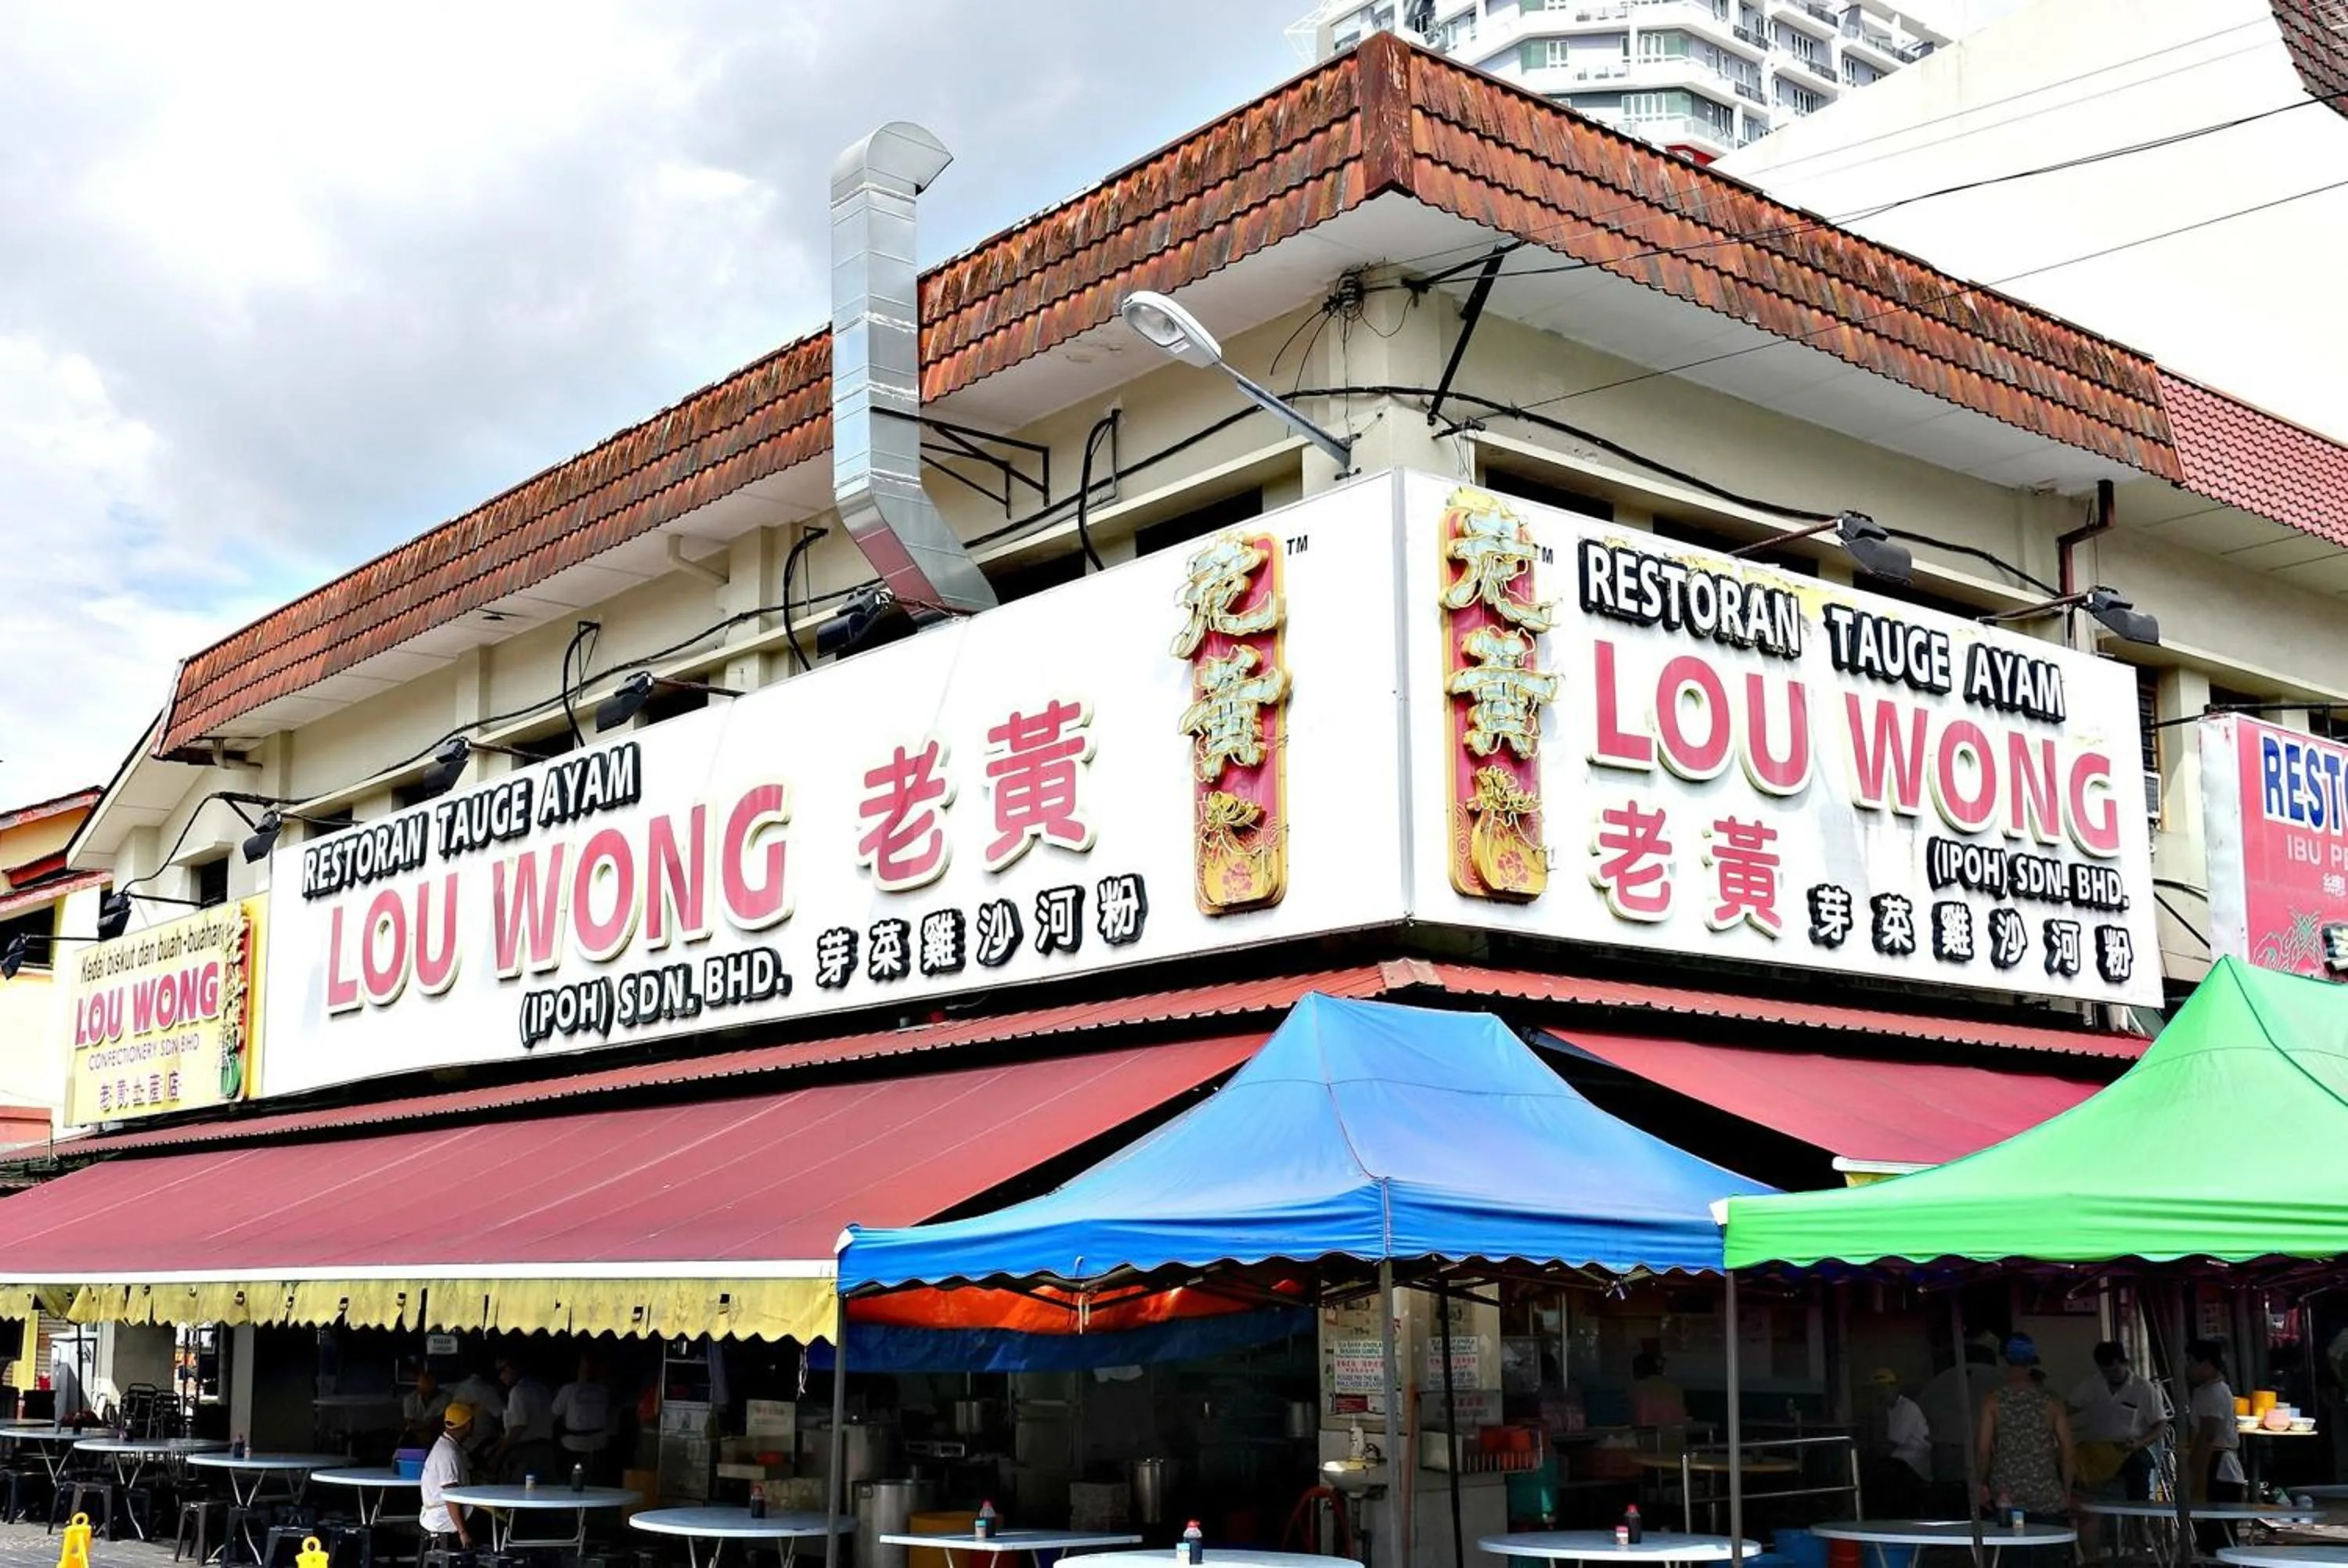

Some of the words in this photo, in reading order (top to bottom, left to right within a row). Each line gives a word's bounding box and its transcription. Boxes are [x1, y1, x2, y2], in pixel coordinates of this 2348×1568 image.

[1286, 534, 1308, 556] TM
[1579, 538, 1802, 660] RESTORAN
[1824, 603, 1950, 694] TAUGE
[1964, 643, 2066, 723] AYAM
[1590, 638, 1813, 795] LOU
[1845, 691, 2122, 858] WONG
[2263, 735, 2348, 832] REST
[303, 811, 428, 897] RESTORAN
[438, 777, 534, 856] TAUGE
[538, 742, 640, 826] AYAM
[2287, 834, 2322, 865] IBU
[327, 871, 460, 1012] LOU
[492, 783, 793, 978] WONG
[1928, 836, 2008, 899] (IPOH)
[2009, 853, 2070, 903] SDN.
[2070, 864, 2130, 912] BHD.
[75, 987, 124, 1046] LOU
[132, 961, 219, 1036] WONG
[81, 951, 106, 984] Kedai
[106, 944, 135, 976] biskut
[138, 940, 156, 967] dan
[520, 977, 613, 1047] (IPOH)
[618, 963, 702, 1029] SDN.
[704, 947, 793, 1009] BHD.
[88, 1042, 157, 1070] CONFECTIONERY
[160, 1038, 178, 1056] SDN
[181, 1034, 200, 1052] BHD
